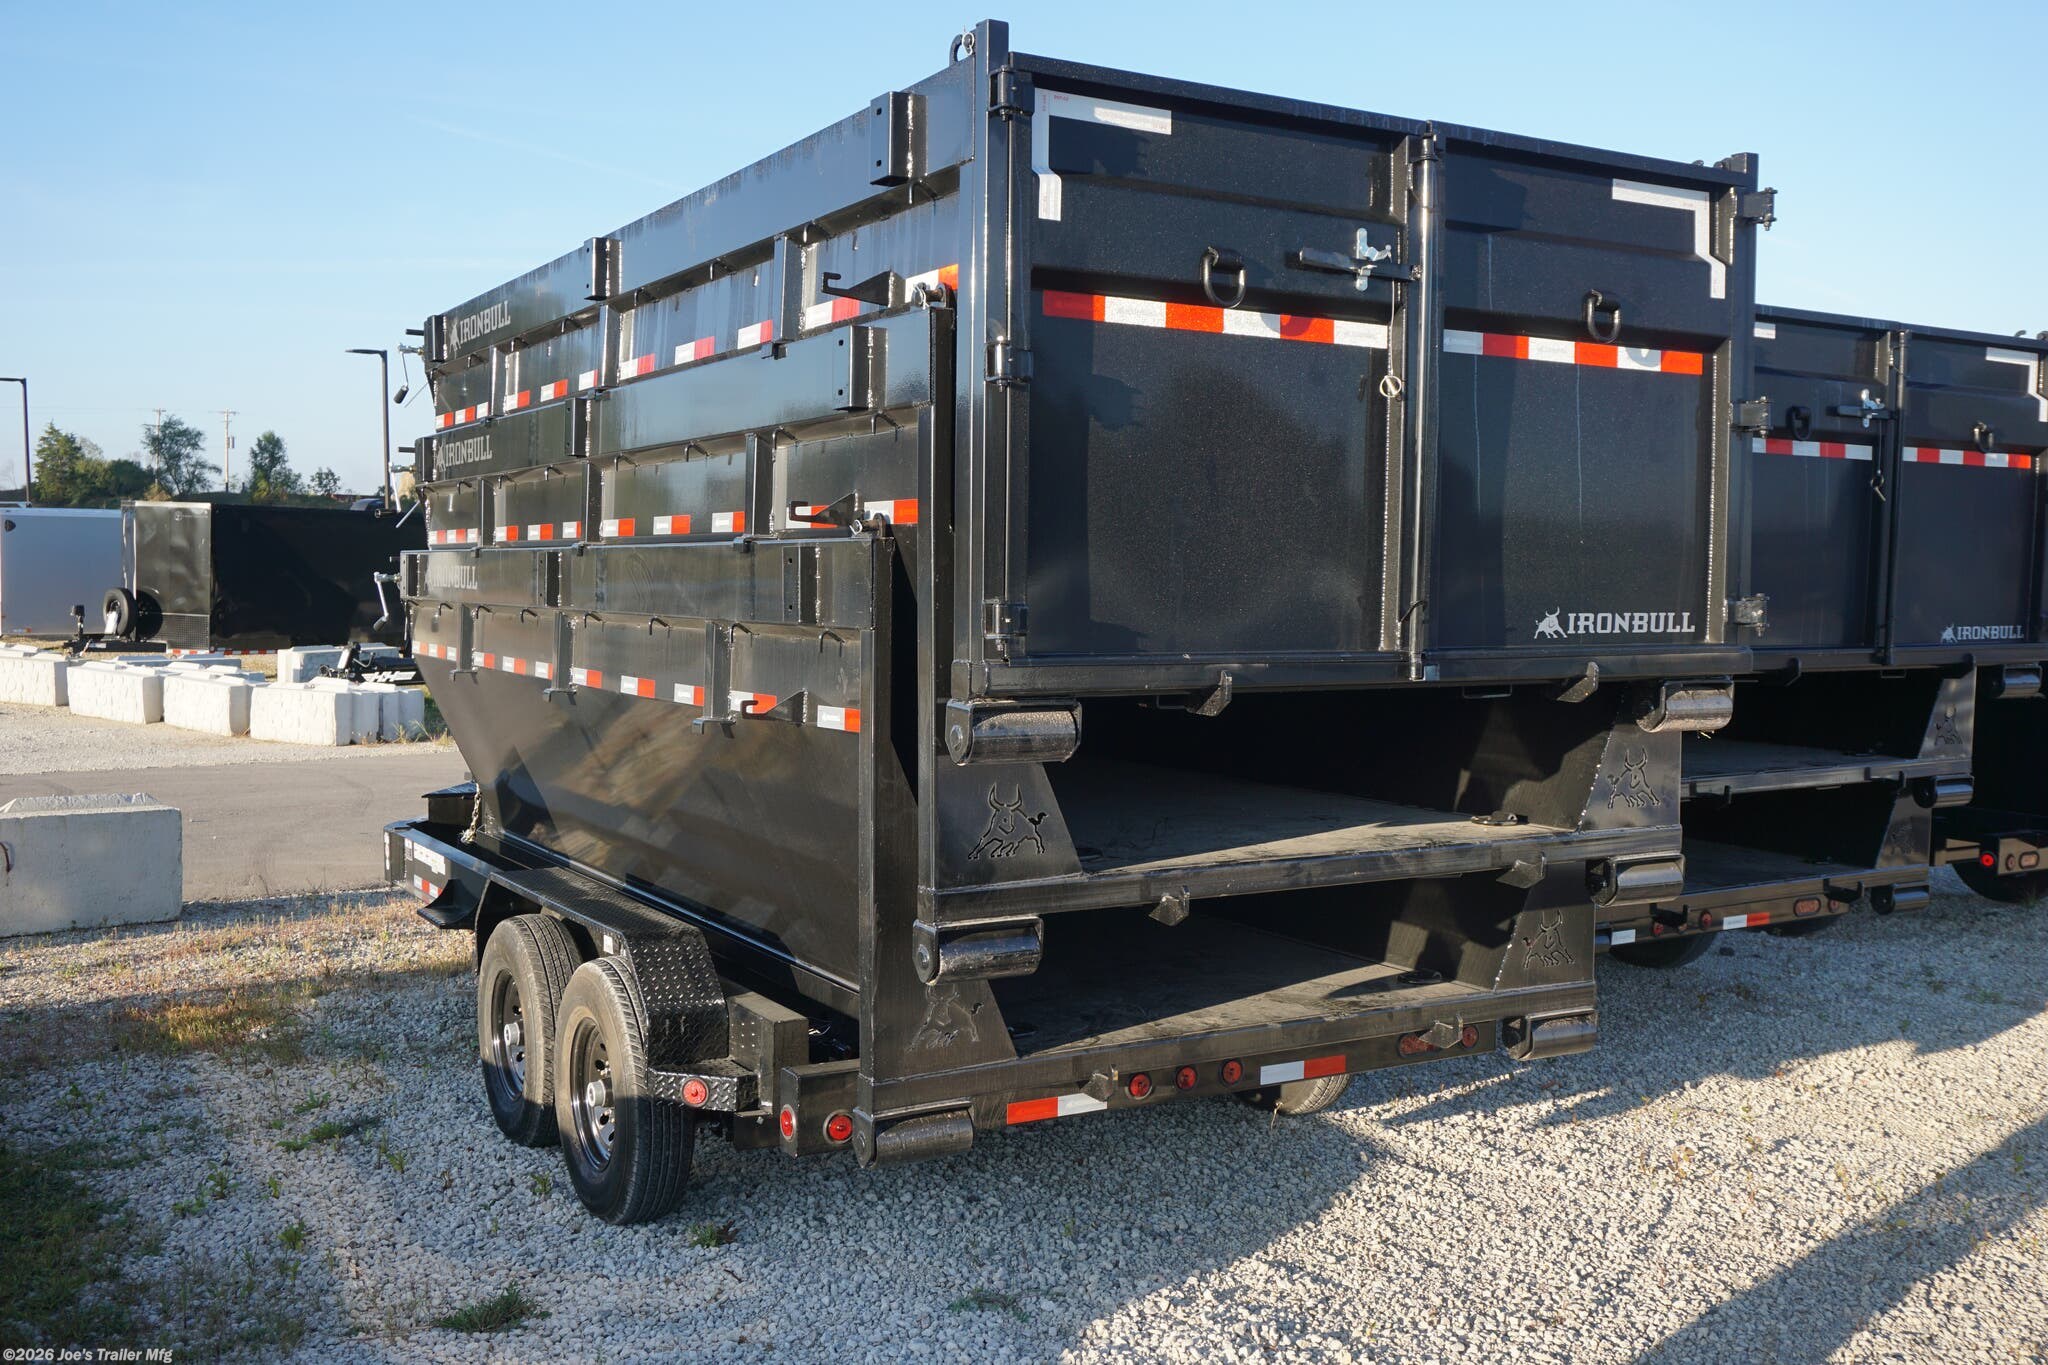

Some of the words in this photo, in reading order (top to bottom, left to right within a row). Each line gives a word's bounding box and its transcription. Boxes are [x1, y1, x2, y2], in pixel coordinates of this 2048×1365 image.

[460, 301, 511, 343] IRONBULL
[445, 435, 493, 467] IRONBULL
[1567, 612, 1696, 634] IRONBULL
[1957, 625, 2025, 640] IRONBULL
